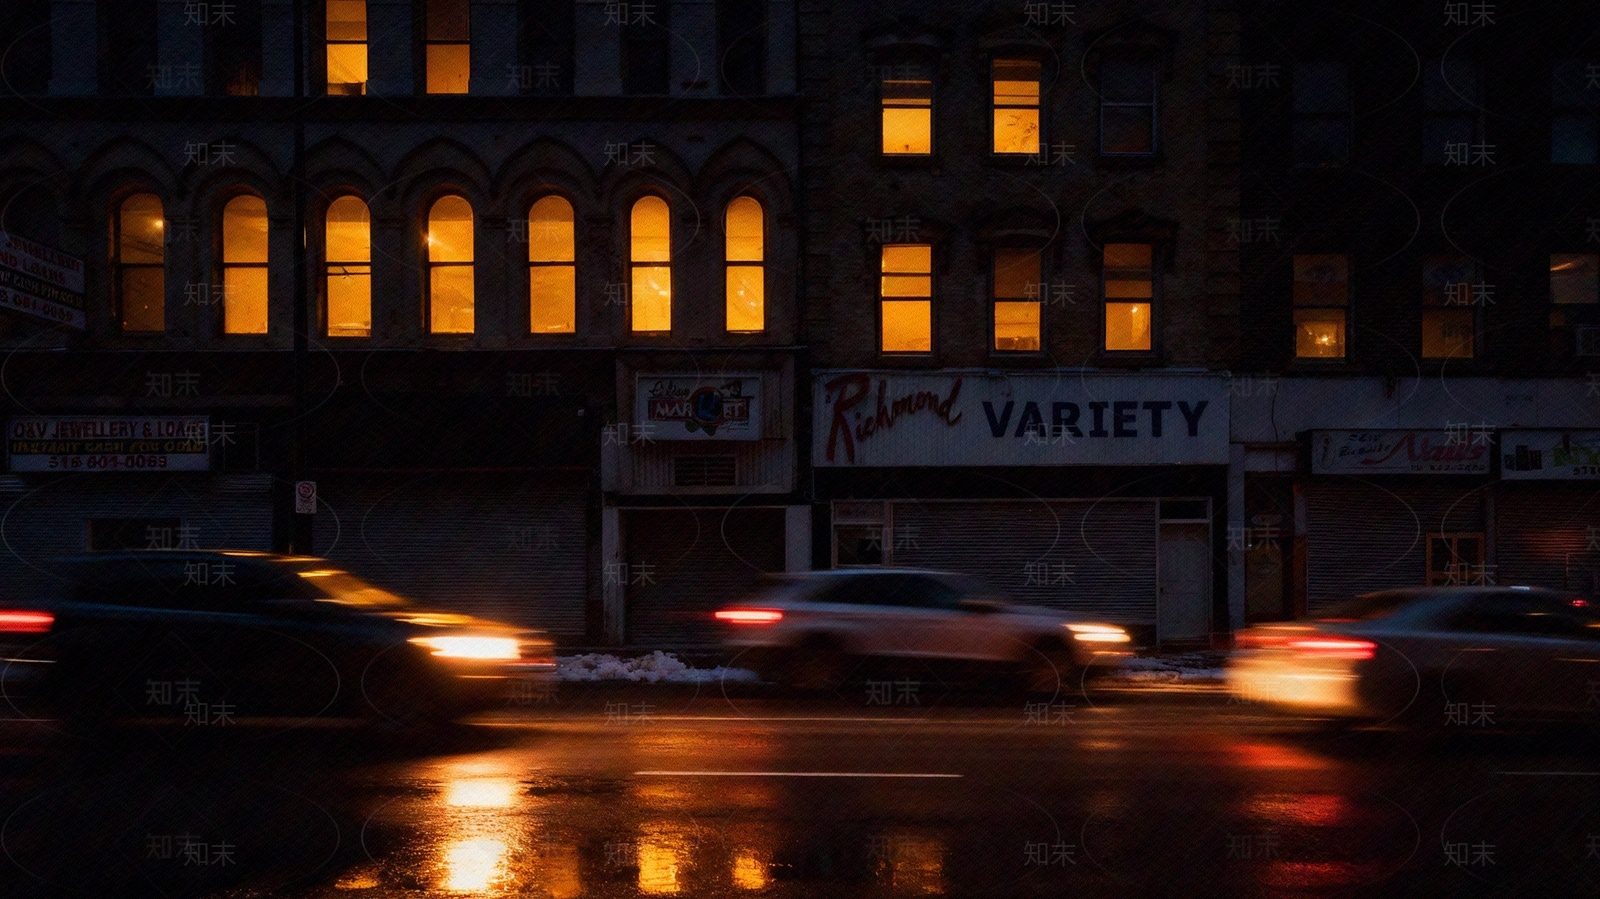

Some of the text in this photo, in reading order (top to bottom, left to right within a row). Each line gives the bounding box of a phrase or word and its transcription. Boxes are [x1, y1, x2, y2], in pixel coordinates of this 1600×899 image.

[655, 393, 743, 420] MARKET
[824, 372, 963, 463] Richmond
[981, 400, 1209, 438] VARIETY
[51, 421, 139, 438] JEWELLERY
[142, 421, 153, 438] &
